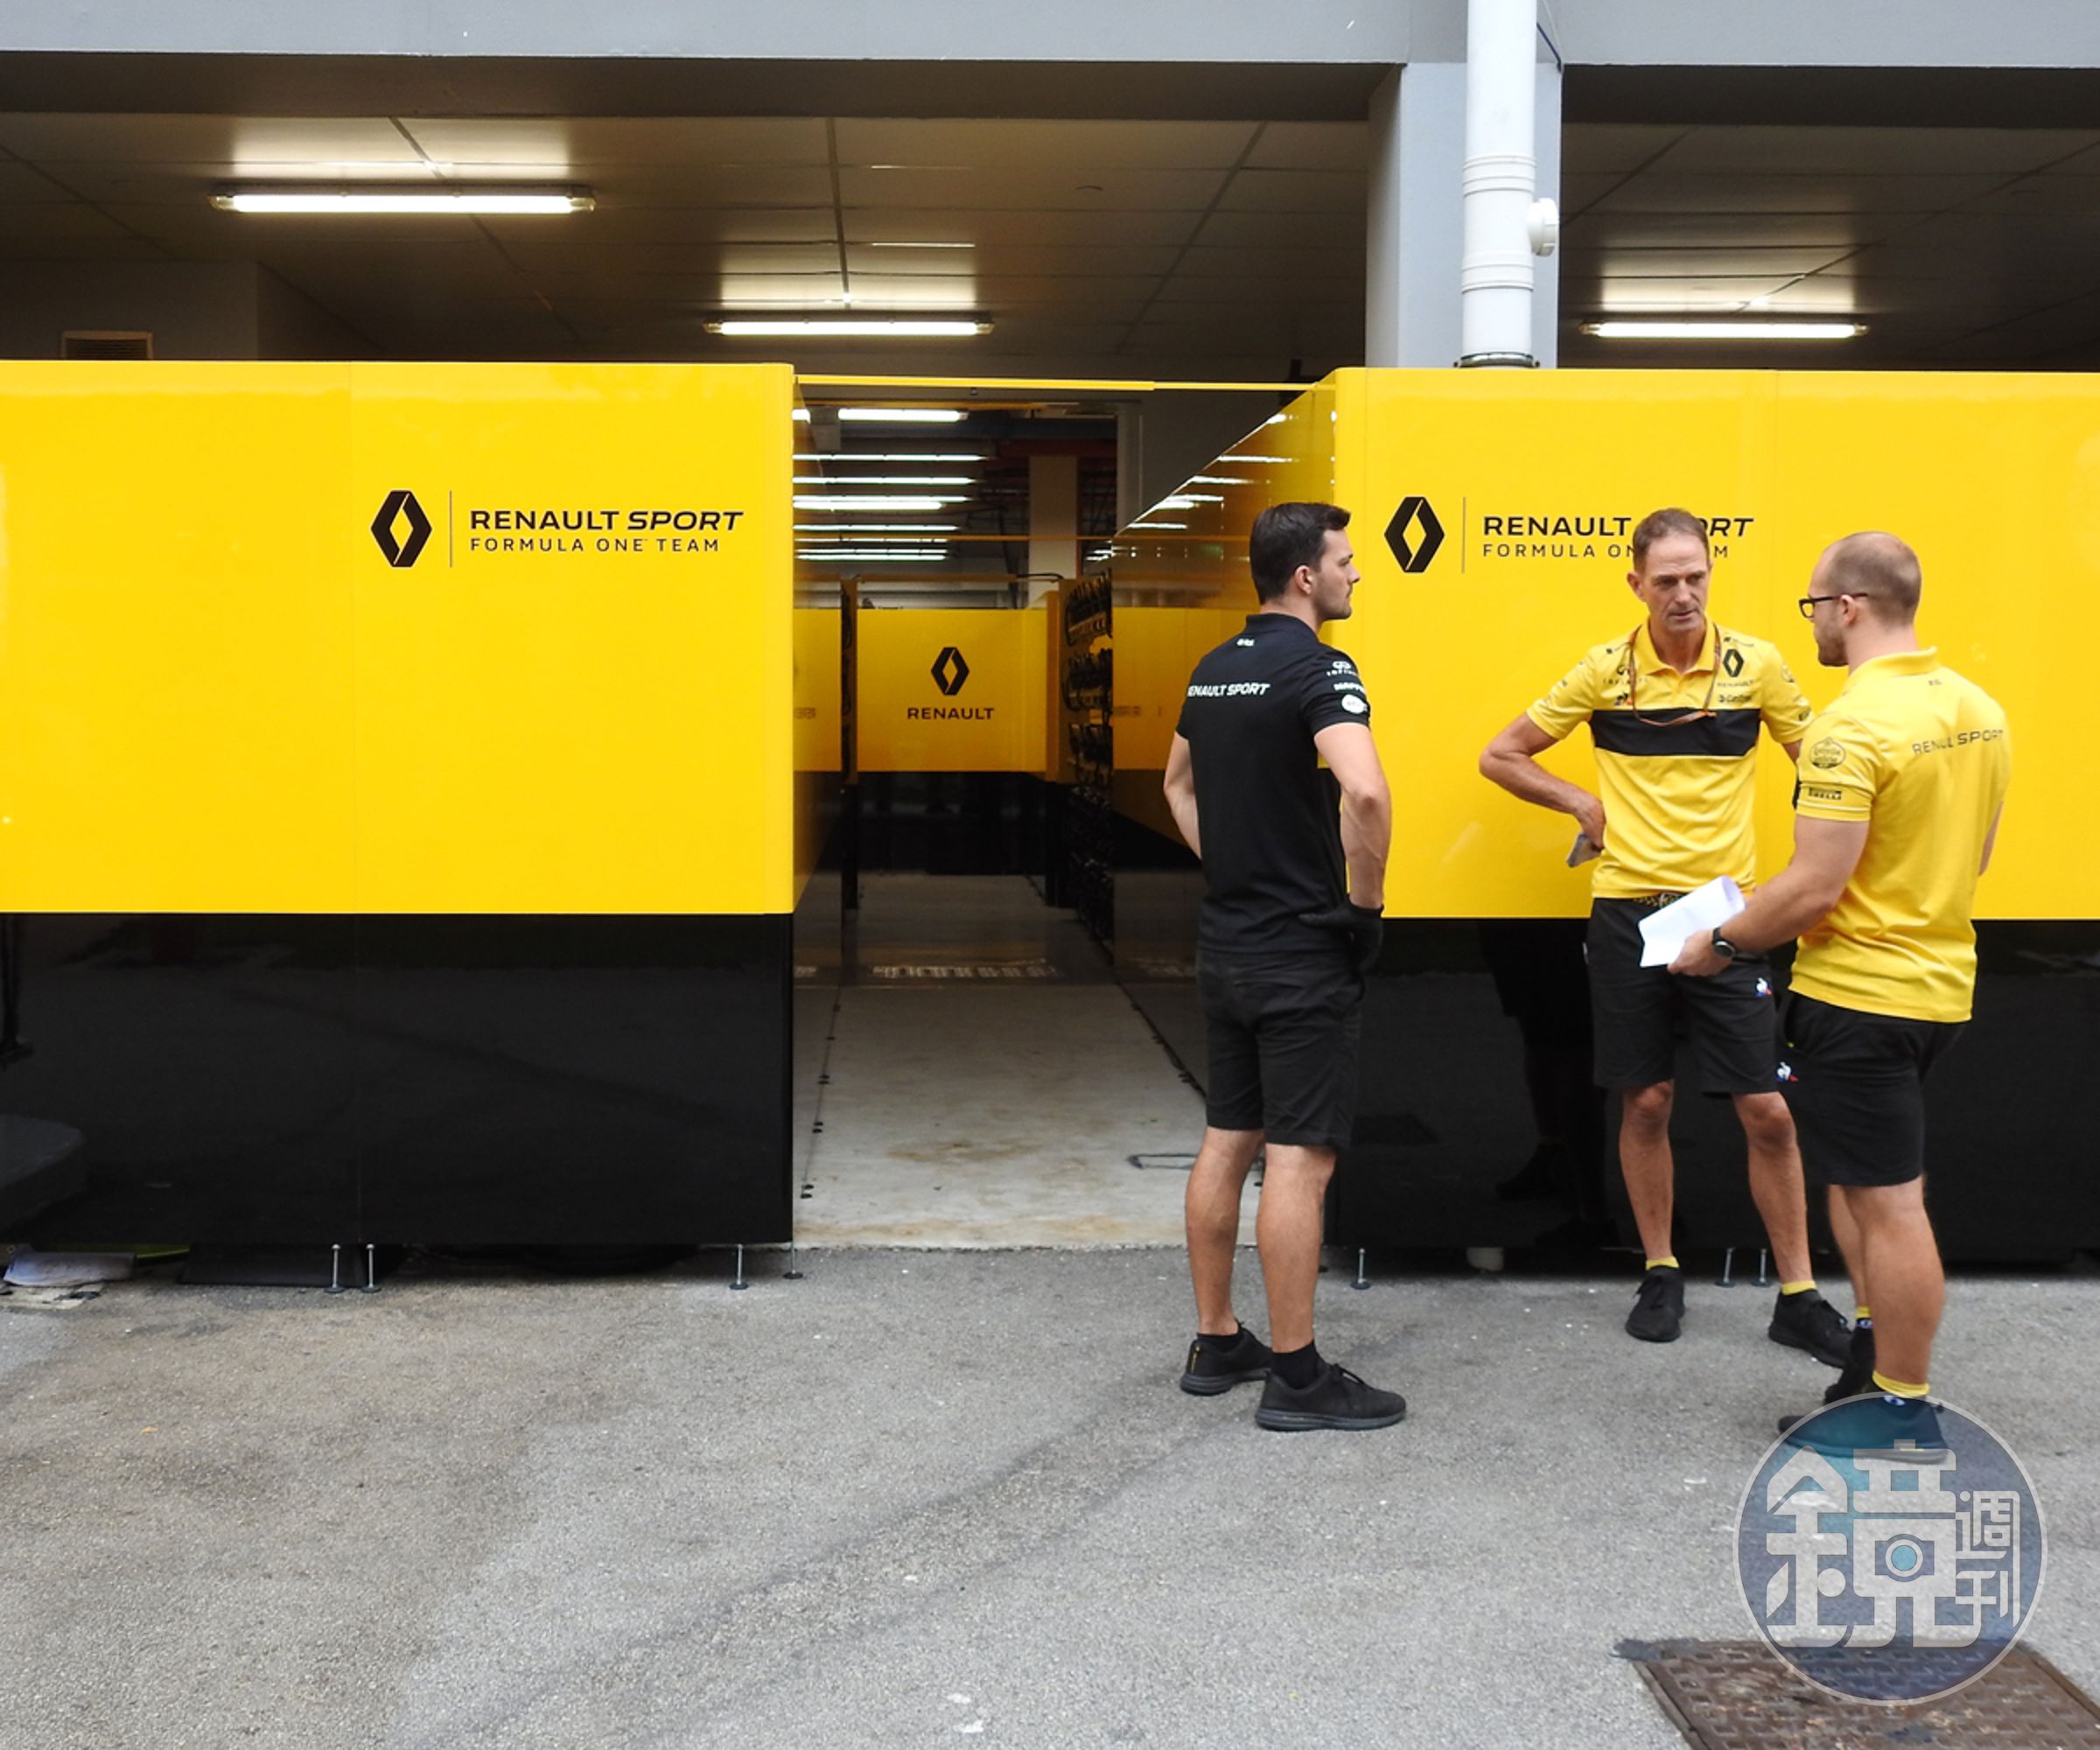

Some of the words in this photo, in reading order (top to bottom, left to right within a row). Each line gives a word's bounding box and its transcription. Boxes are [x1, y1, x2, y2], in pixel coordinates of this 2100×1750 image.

[470, 510, 620, 530] RENAULT
[626, 510, 744, 530] SPORT
[1483, 516, 1632, 536] RENAULT
[470, 537, 584, 552] FORMULA
[596, 537, 644, 552] ONE
[657, 537, 719, 552] TEAM
[1483, 543, 1595, 557] FORMULA
[1607, 543, 1634, 558] ON
[1227, 682, 1270, 696] SPORT
[907, 707, 995, 720] RENAULT
